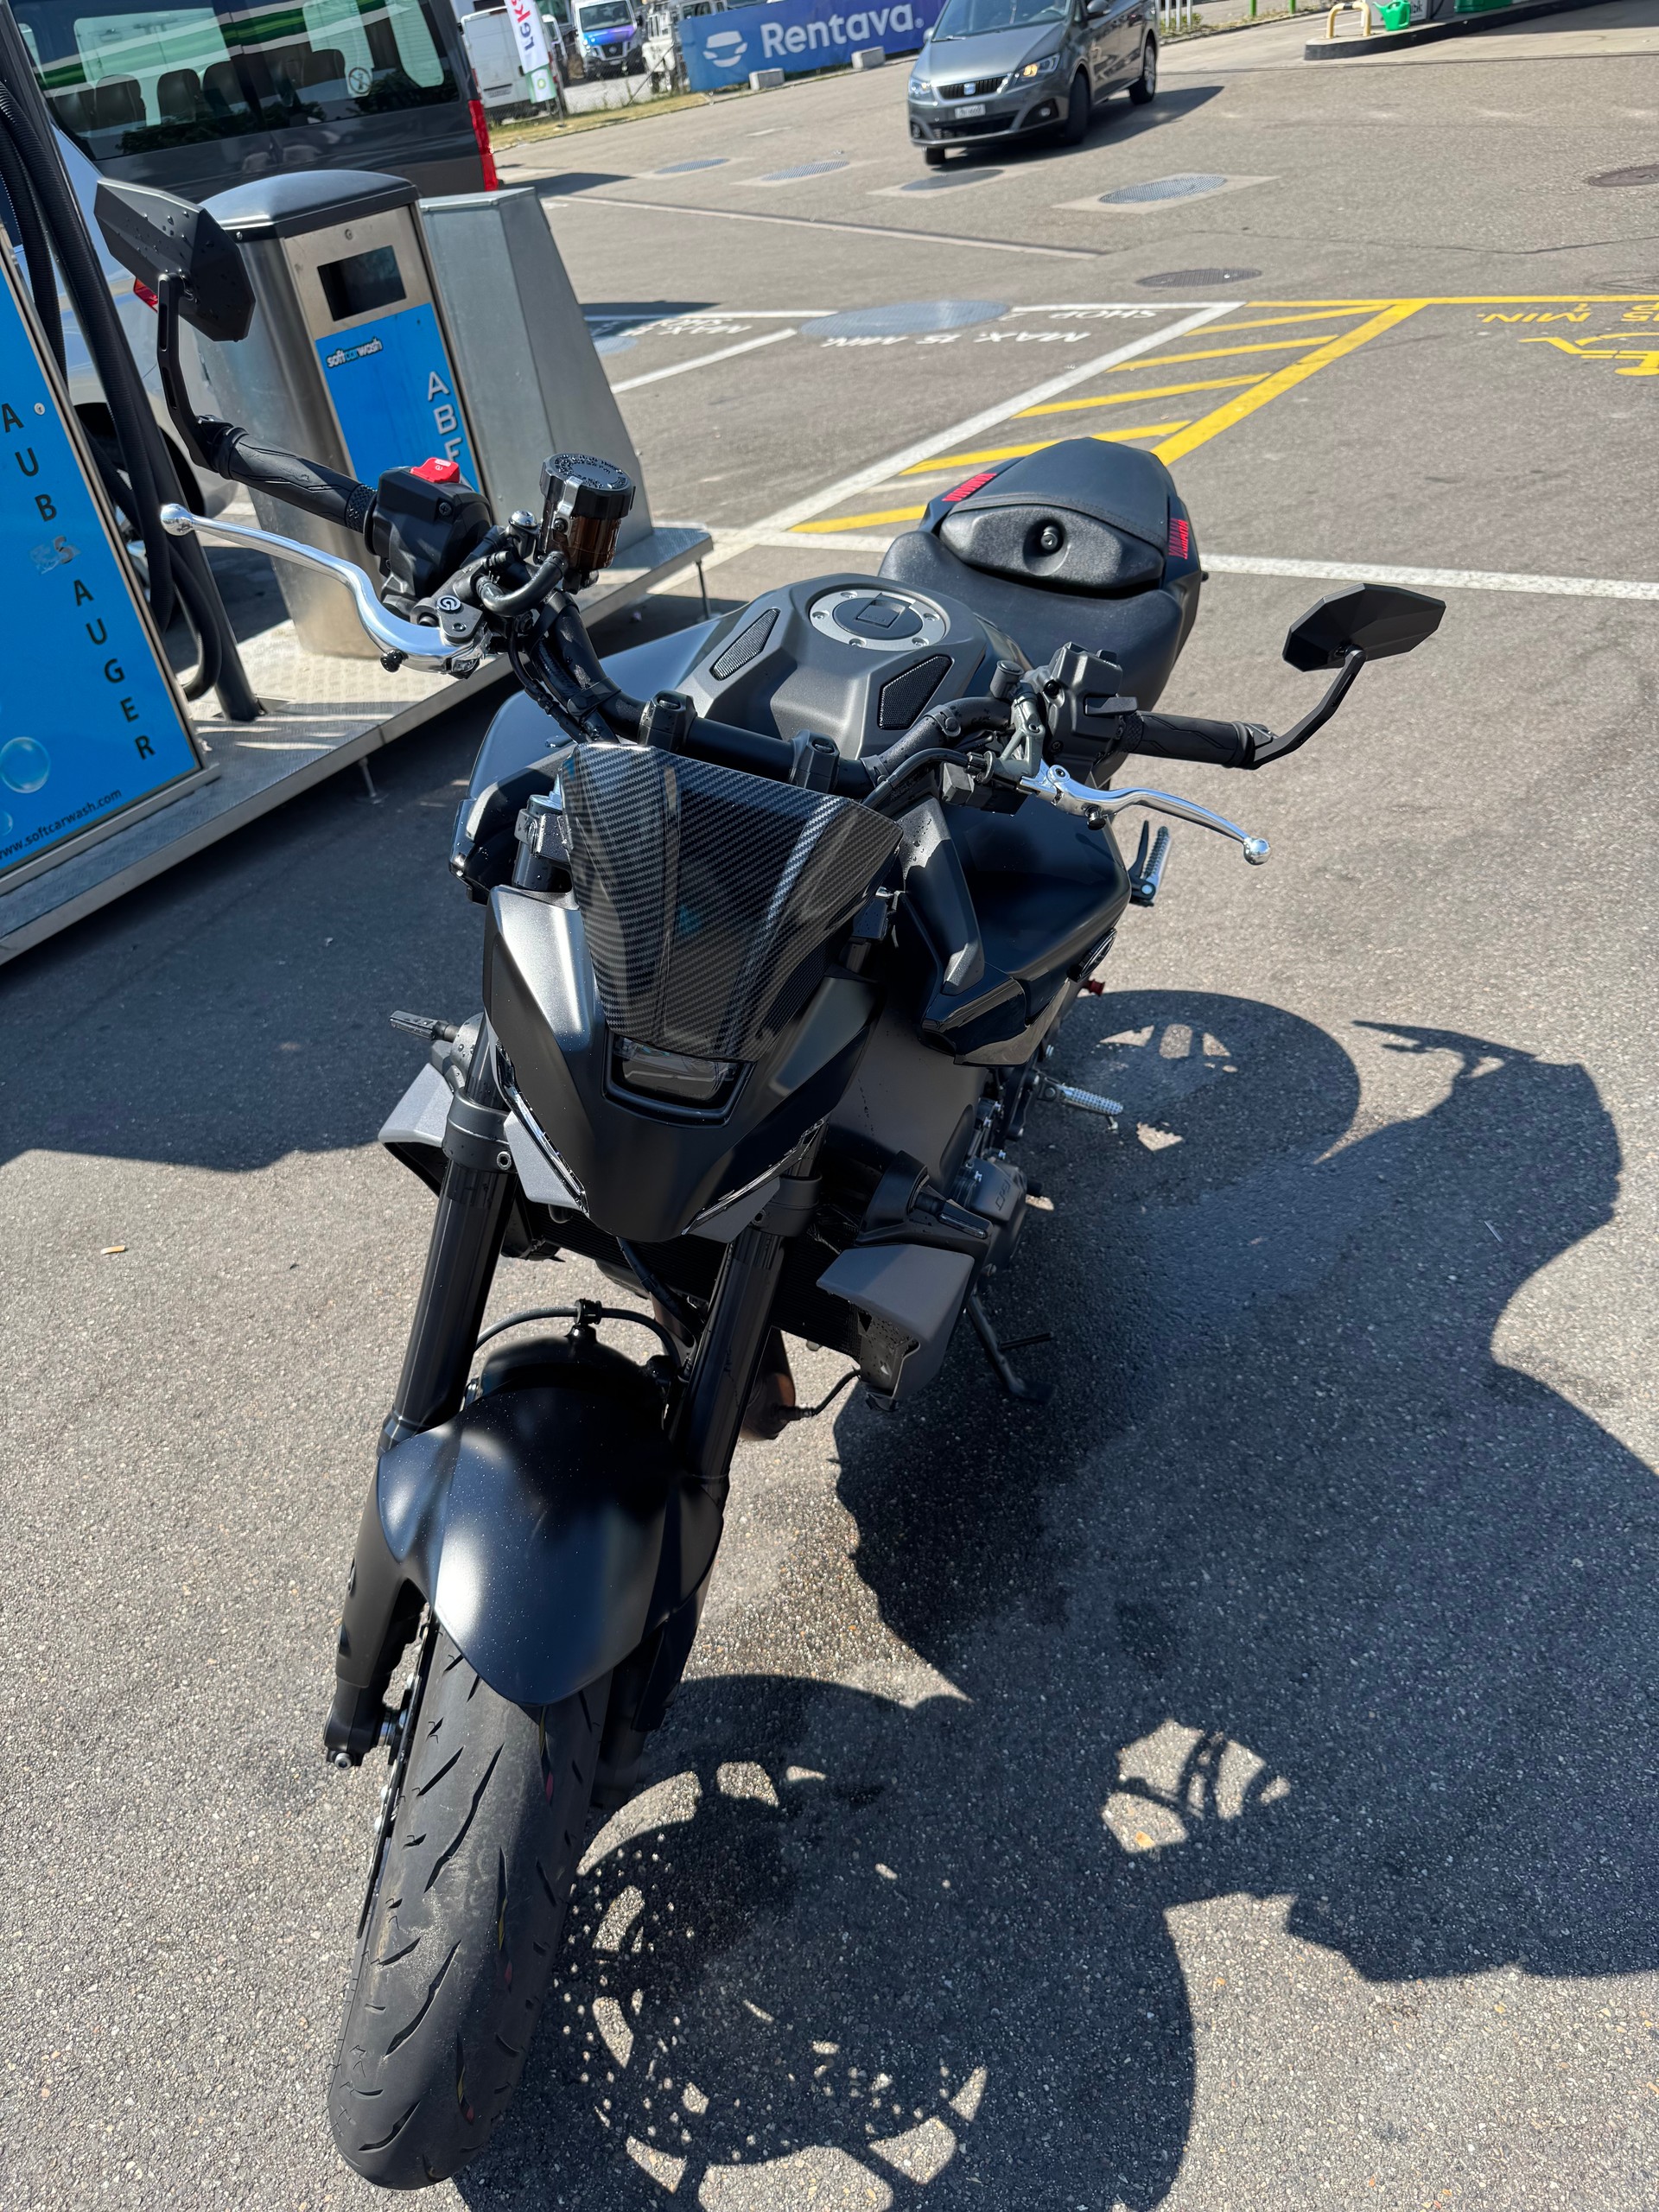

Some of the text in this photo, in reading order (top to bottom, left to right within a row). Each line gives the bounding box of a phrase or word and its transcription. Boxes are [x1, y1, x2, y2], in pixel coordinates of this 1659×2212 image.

[821, 335, 909, 347] MIN.
[974, 332, 1091, 343] MAX.
[0, 789, 122, 860] ww.softcarwash.com
